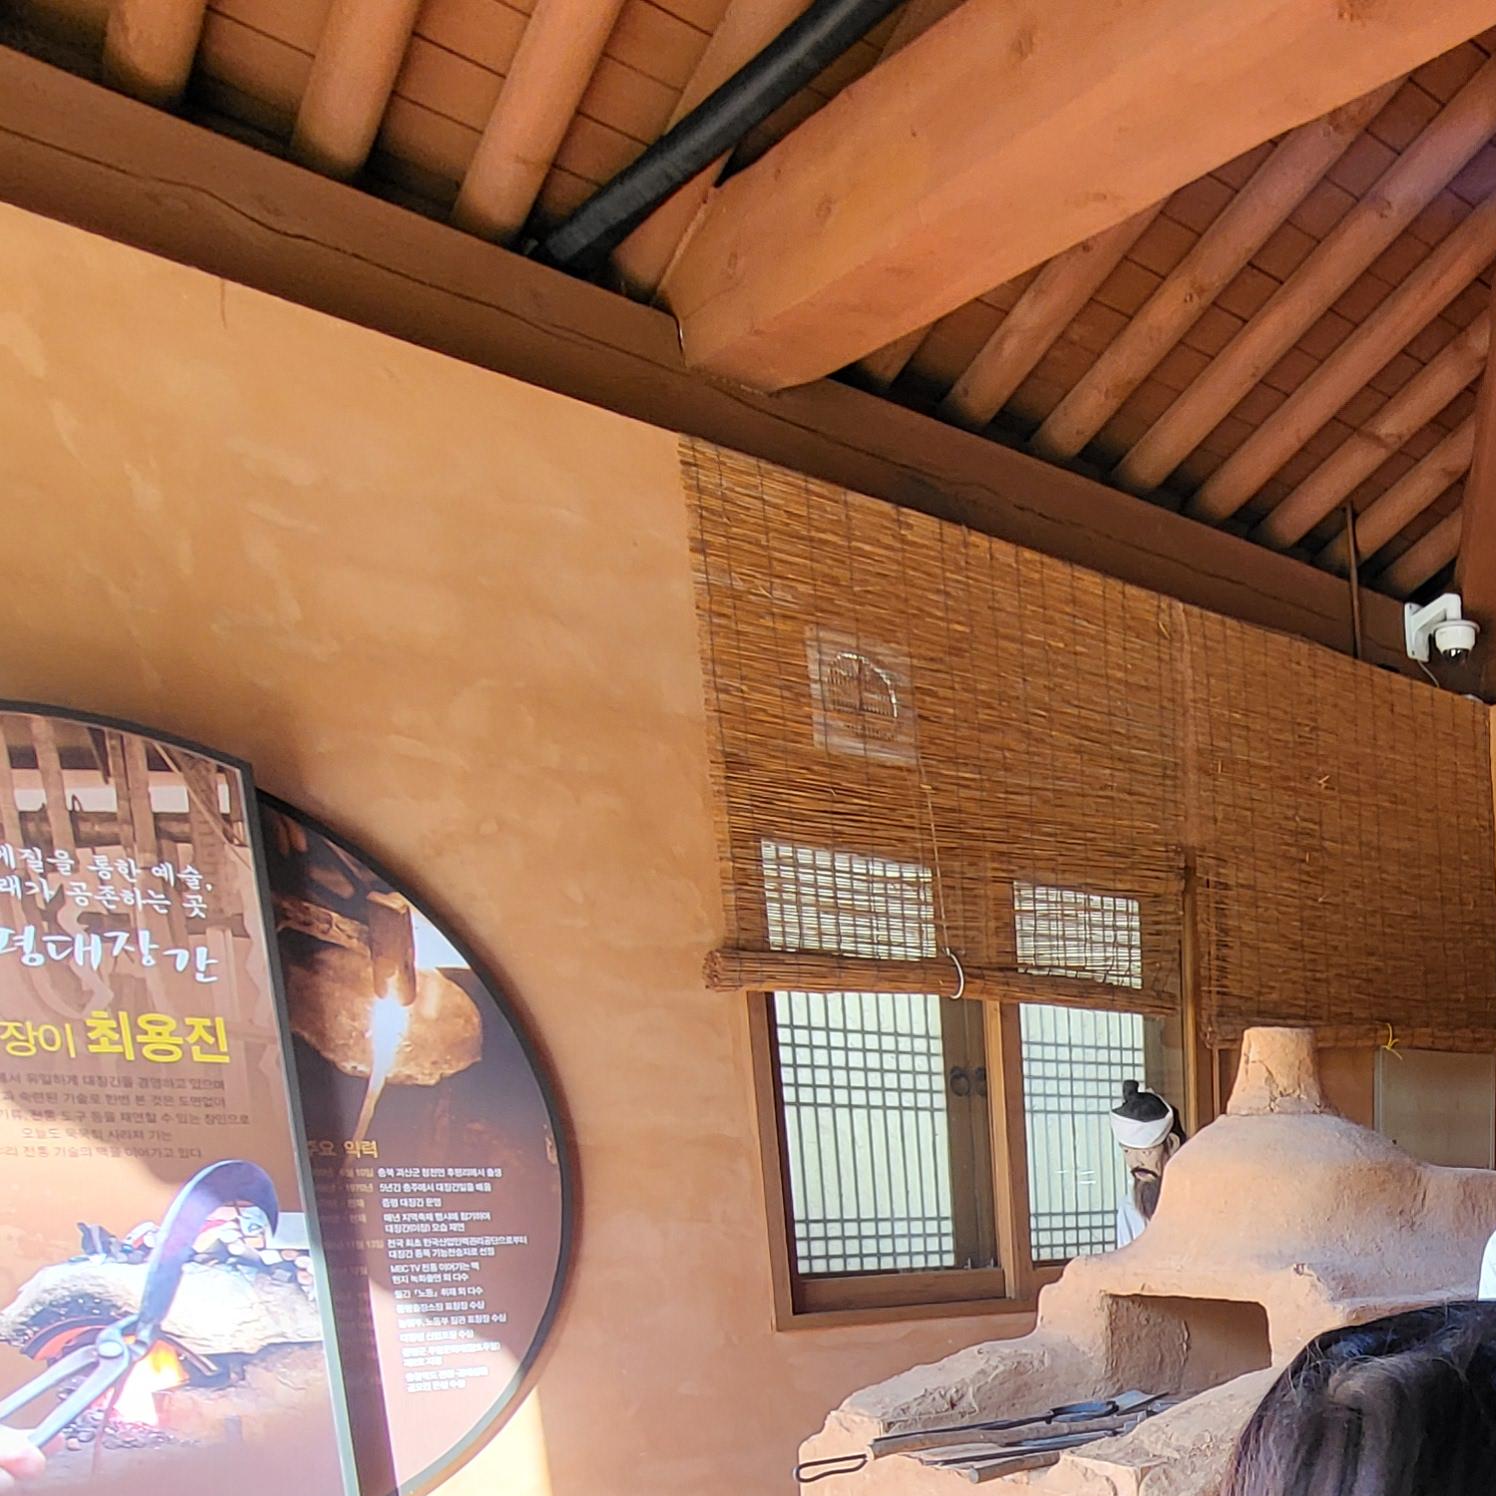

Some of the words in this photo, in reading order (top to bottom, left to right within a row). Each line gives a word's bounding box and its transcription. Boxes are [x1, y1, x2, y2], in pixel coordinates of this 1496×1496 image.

[87, 854, 142, 883] 통한
[151, 861, 214, 892] 예술,
[65, 881, 172, 915] 공존하는
[182, 893, 208, 919] 곳
[85, 1010, 231, 1063] 최용진
[343, 1140, 378, 1159] 약력
